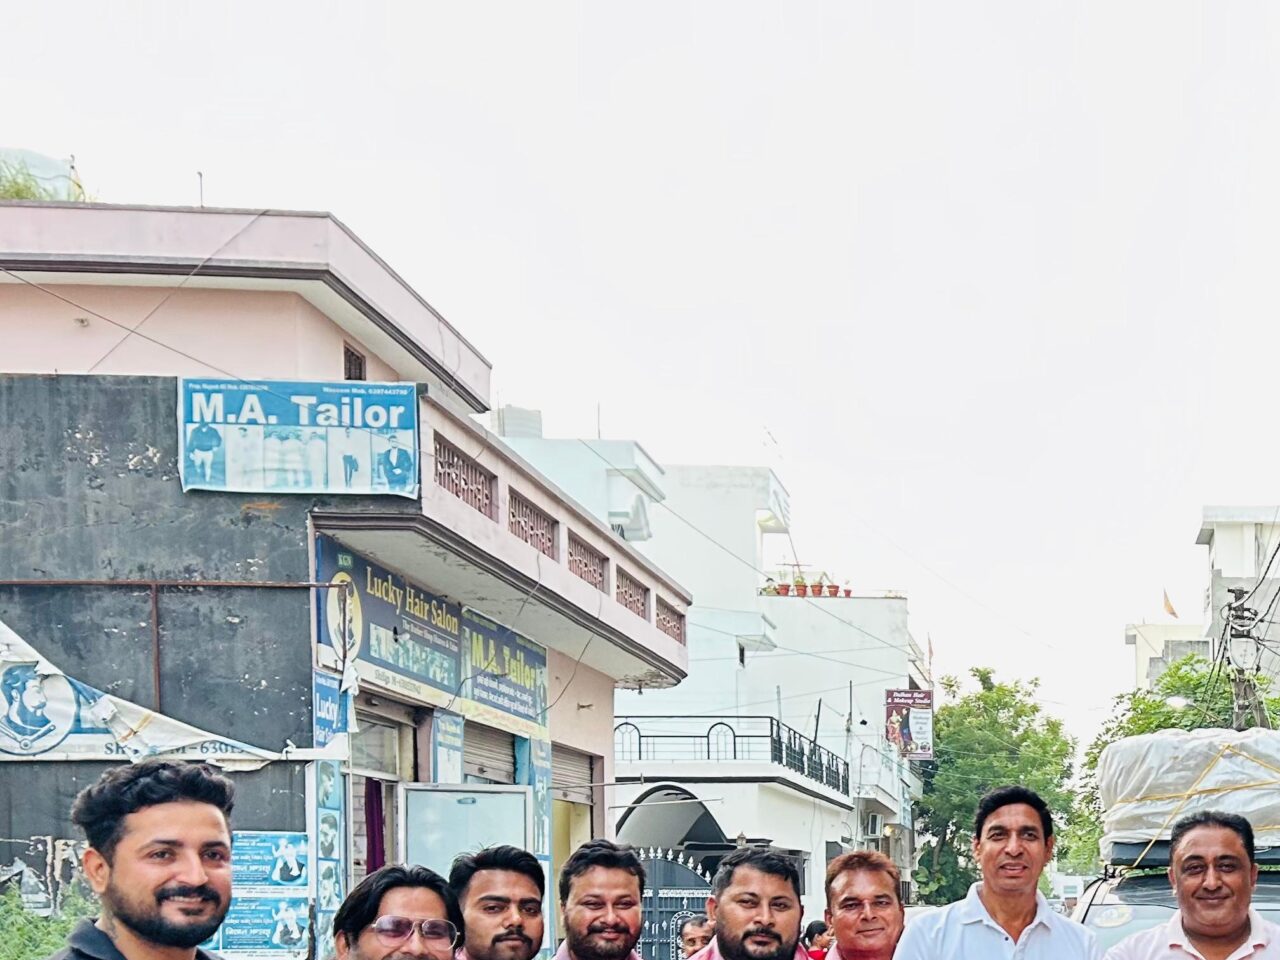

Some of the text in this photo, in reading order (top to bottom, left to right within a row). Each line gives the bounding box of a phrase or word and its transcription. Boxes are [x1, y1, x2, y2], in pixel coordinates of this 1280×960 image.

[191, 392, 405, 428] M.A. Tailor
[366, 566, 403, 615] Lucky
[406, 586, 430, 621] Hair
[432, 600, 459, 635] Salon
[503, 645, 536, 691] Tailor
[315, 692, 338, 730] Lucky
